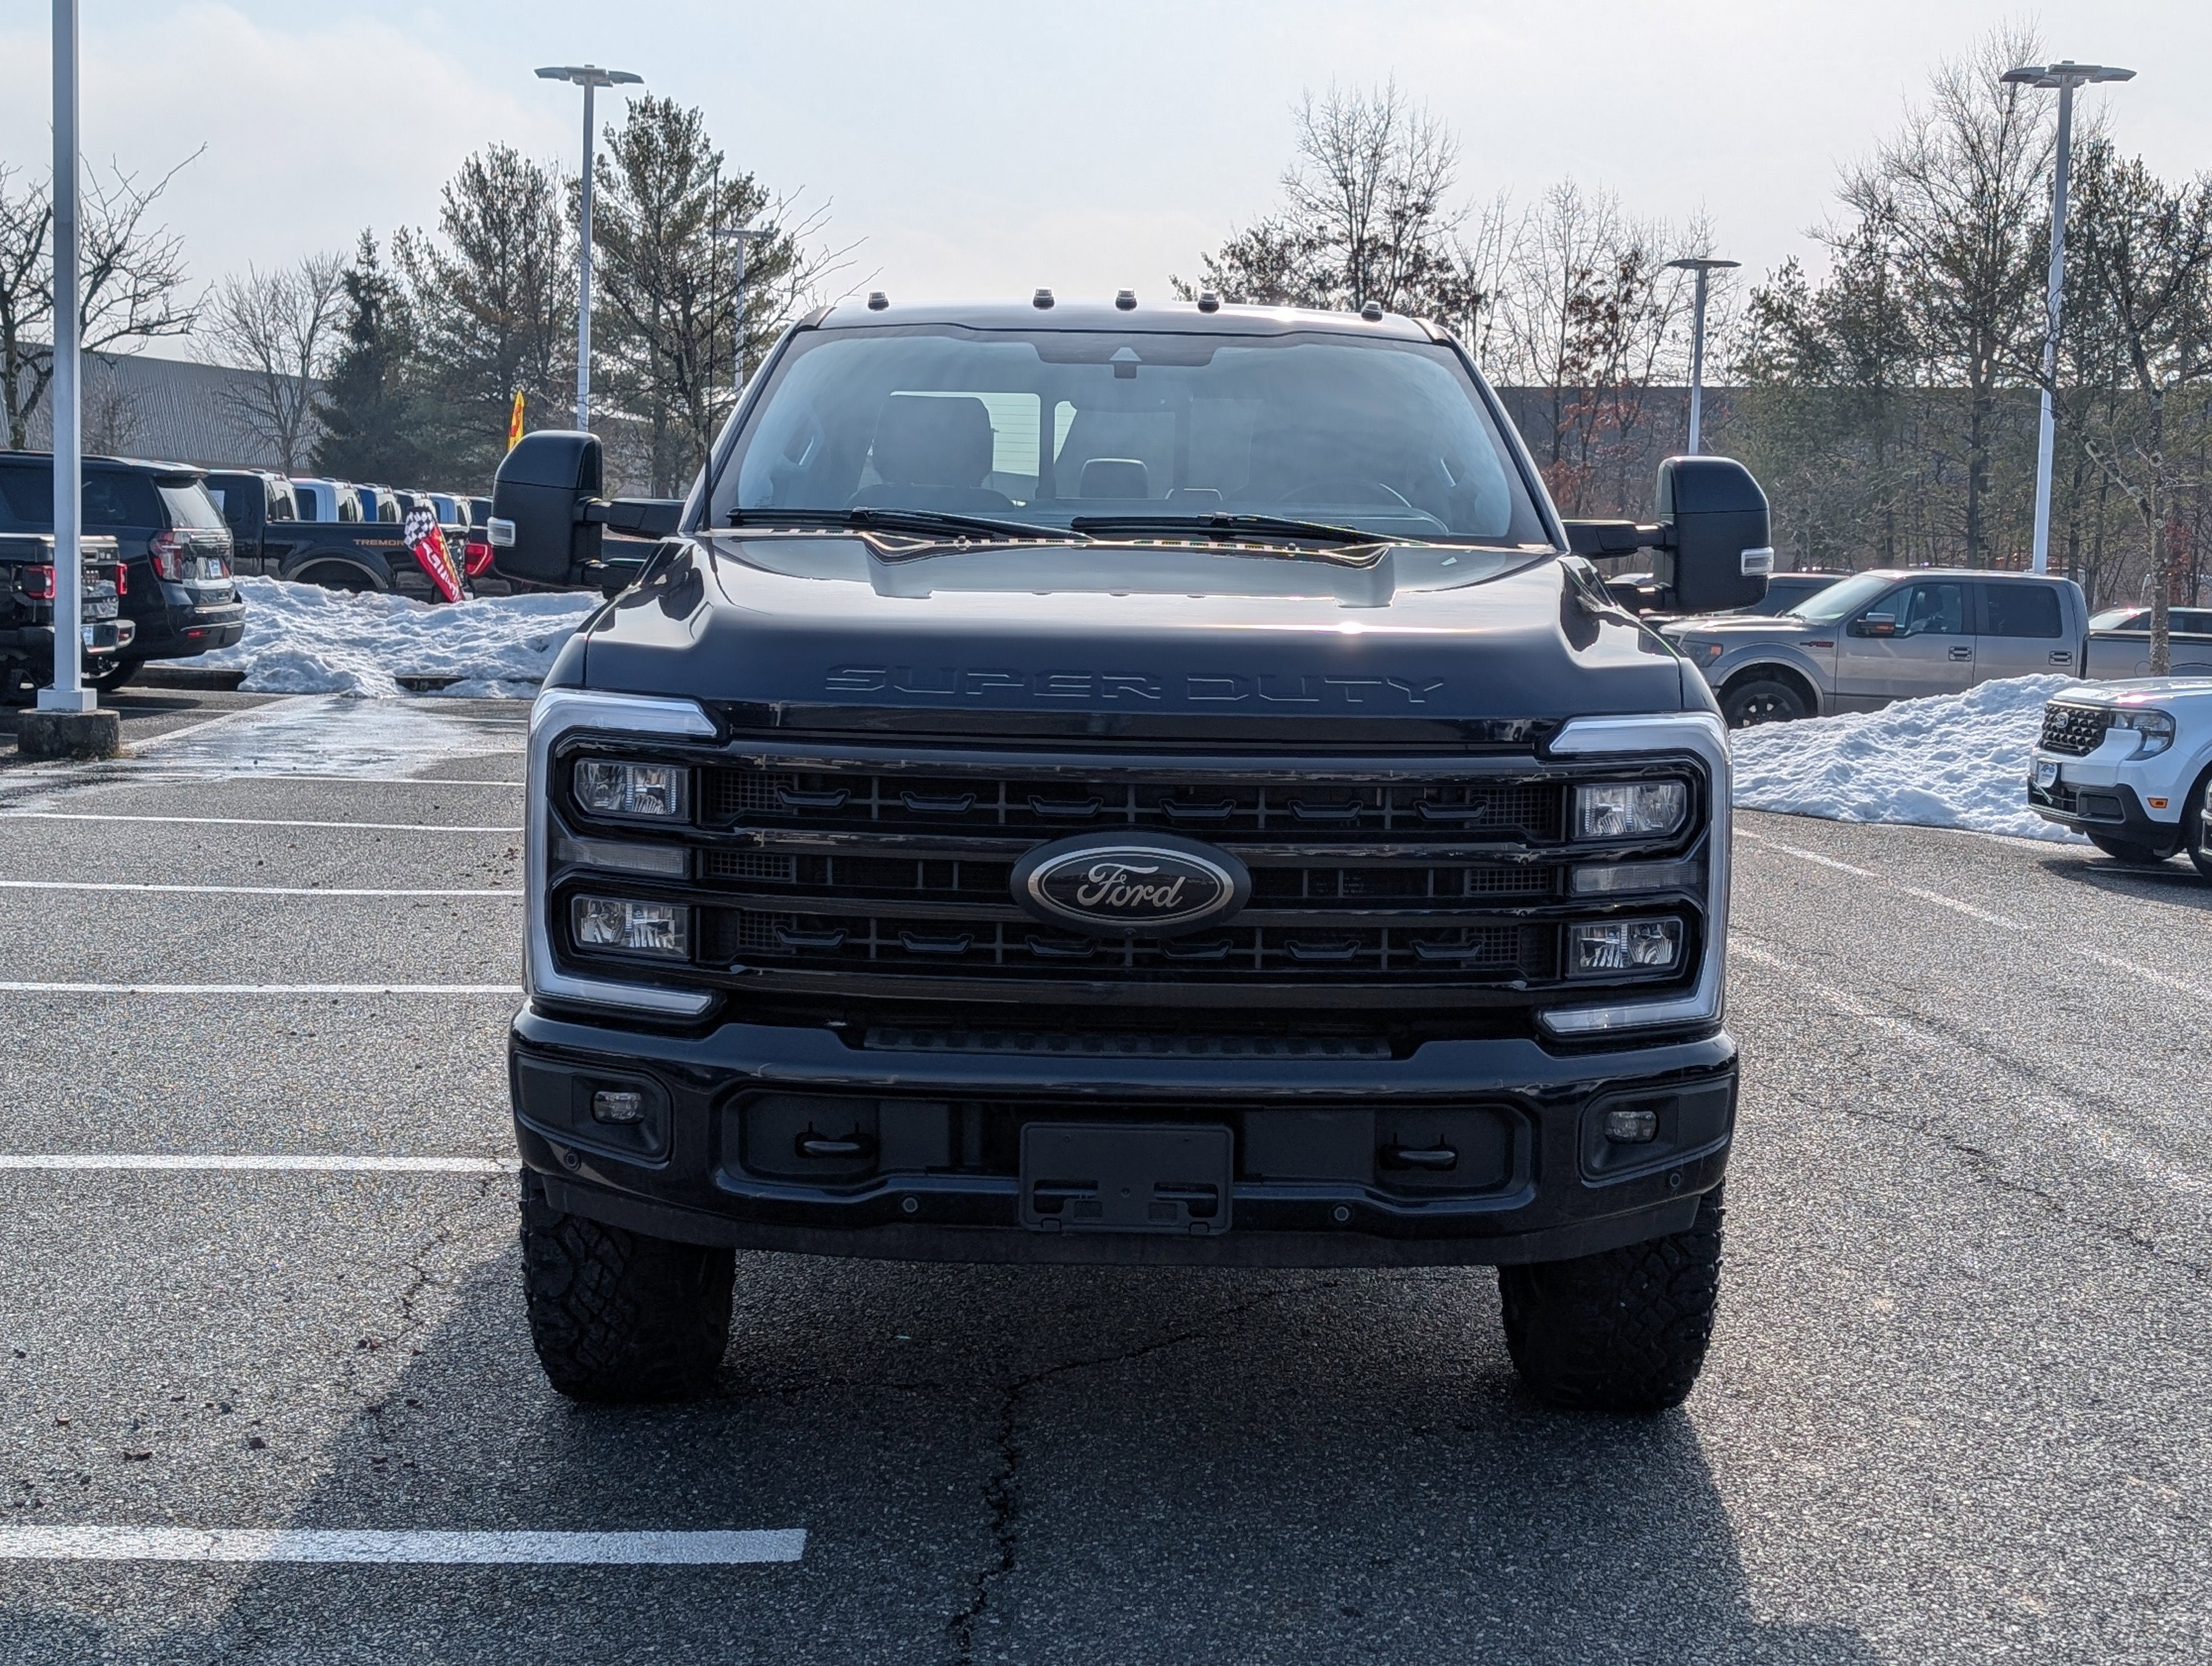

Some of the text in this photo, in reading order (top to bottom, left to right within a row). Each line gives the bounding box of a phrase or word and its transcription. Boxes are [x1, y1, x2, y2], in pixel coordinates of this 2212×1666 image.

[826, 664, 1444, 702] SUPER DUTY
[1077, 862, 1186, 908] Ford
